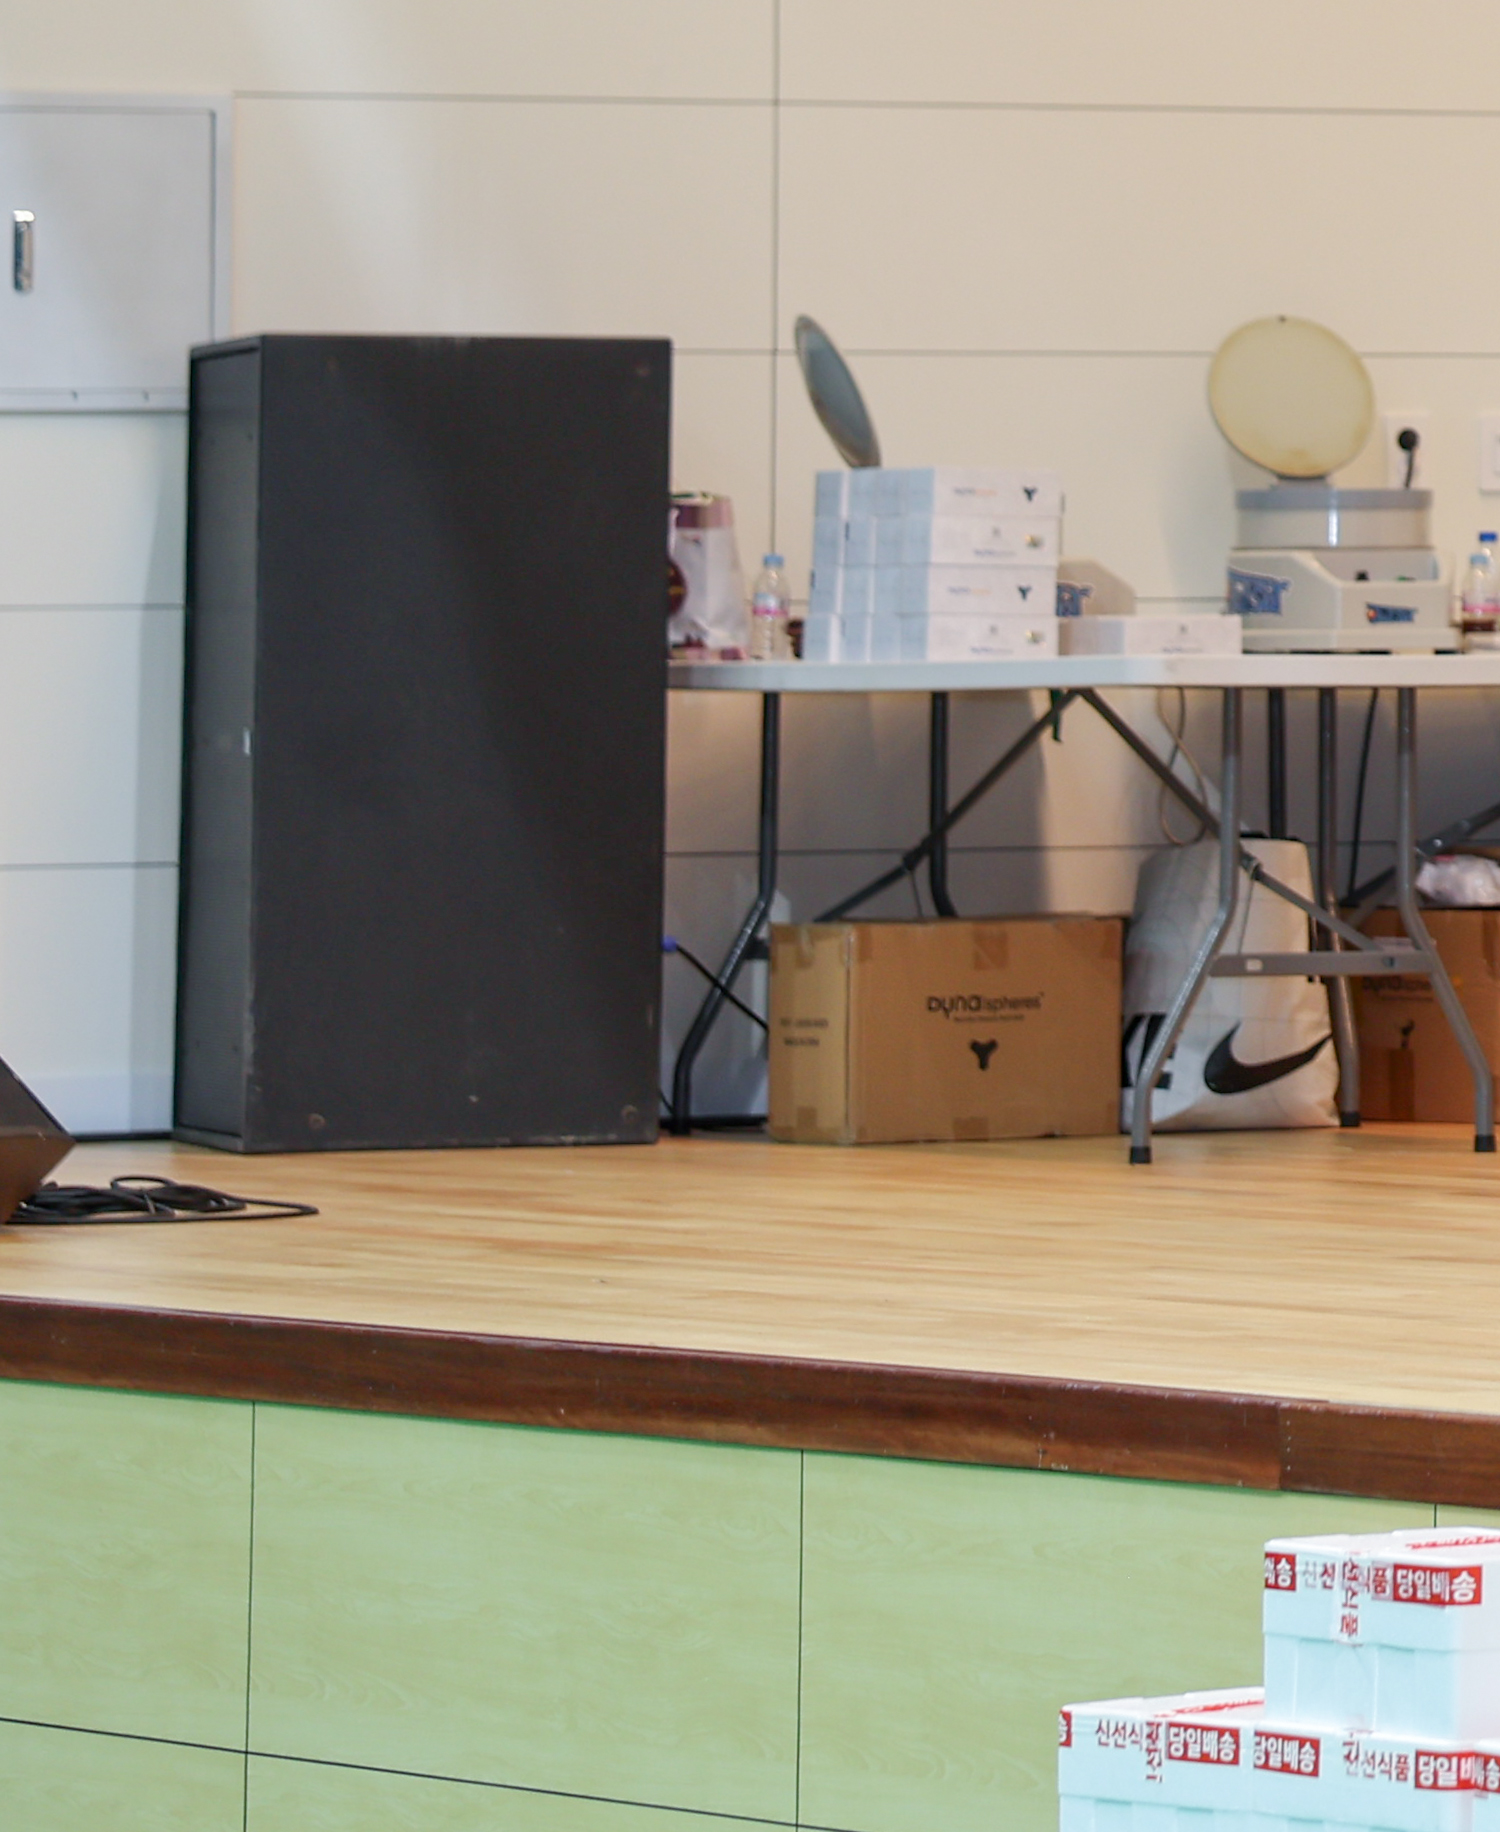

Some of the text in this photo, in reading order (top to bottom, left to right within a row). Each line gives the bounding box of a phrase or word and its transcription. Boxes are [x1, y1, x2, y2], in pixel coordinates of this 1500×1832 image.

[1396, 1567, 1478, 1604] 당일배송
[1095, 1719, 1143, 1752] 신선식
[1168, 1724, 1237, 1762] 당일배송
[1254, 1734, 1317, 1773] 당일배송
[1417, 1752, 1500, 1792] 당일배송
